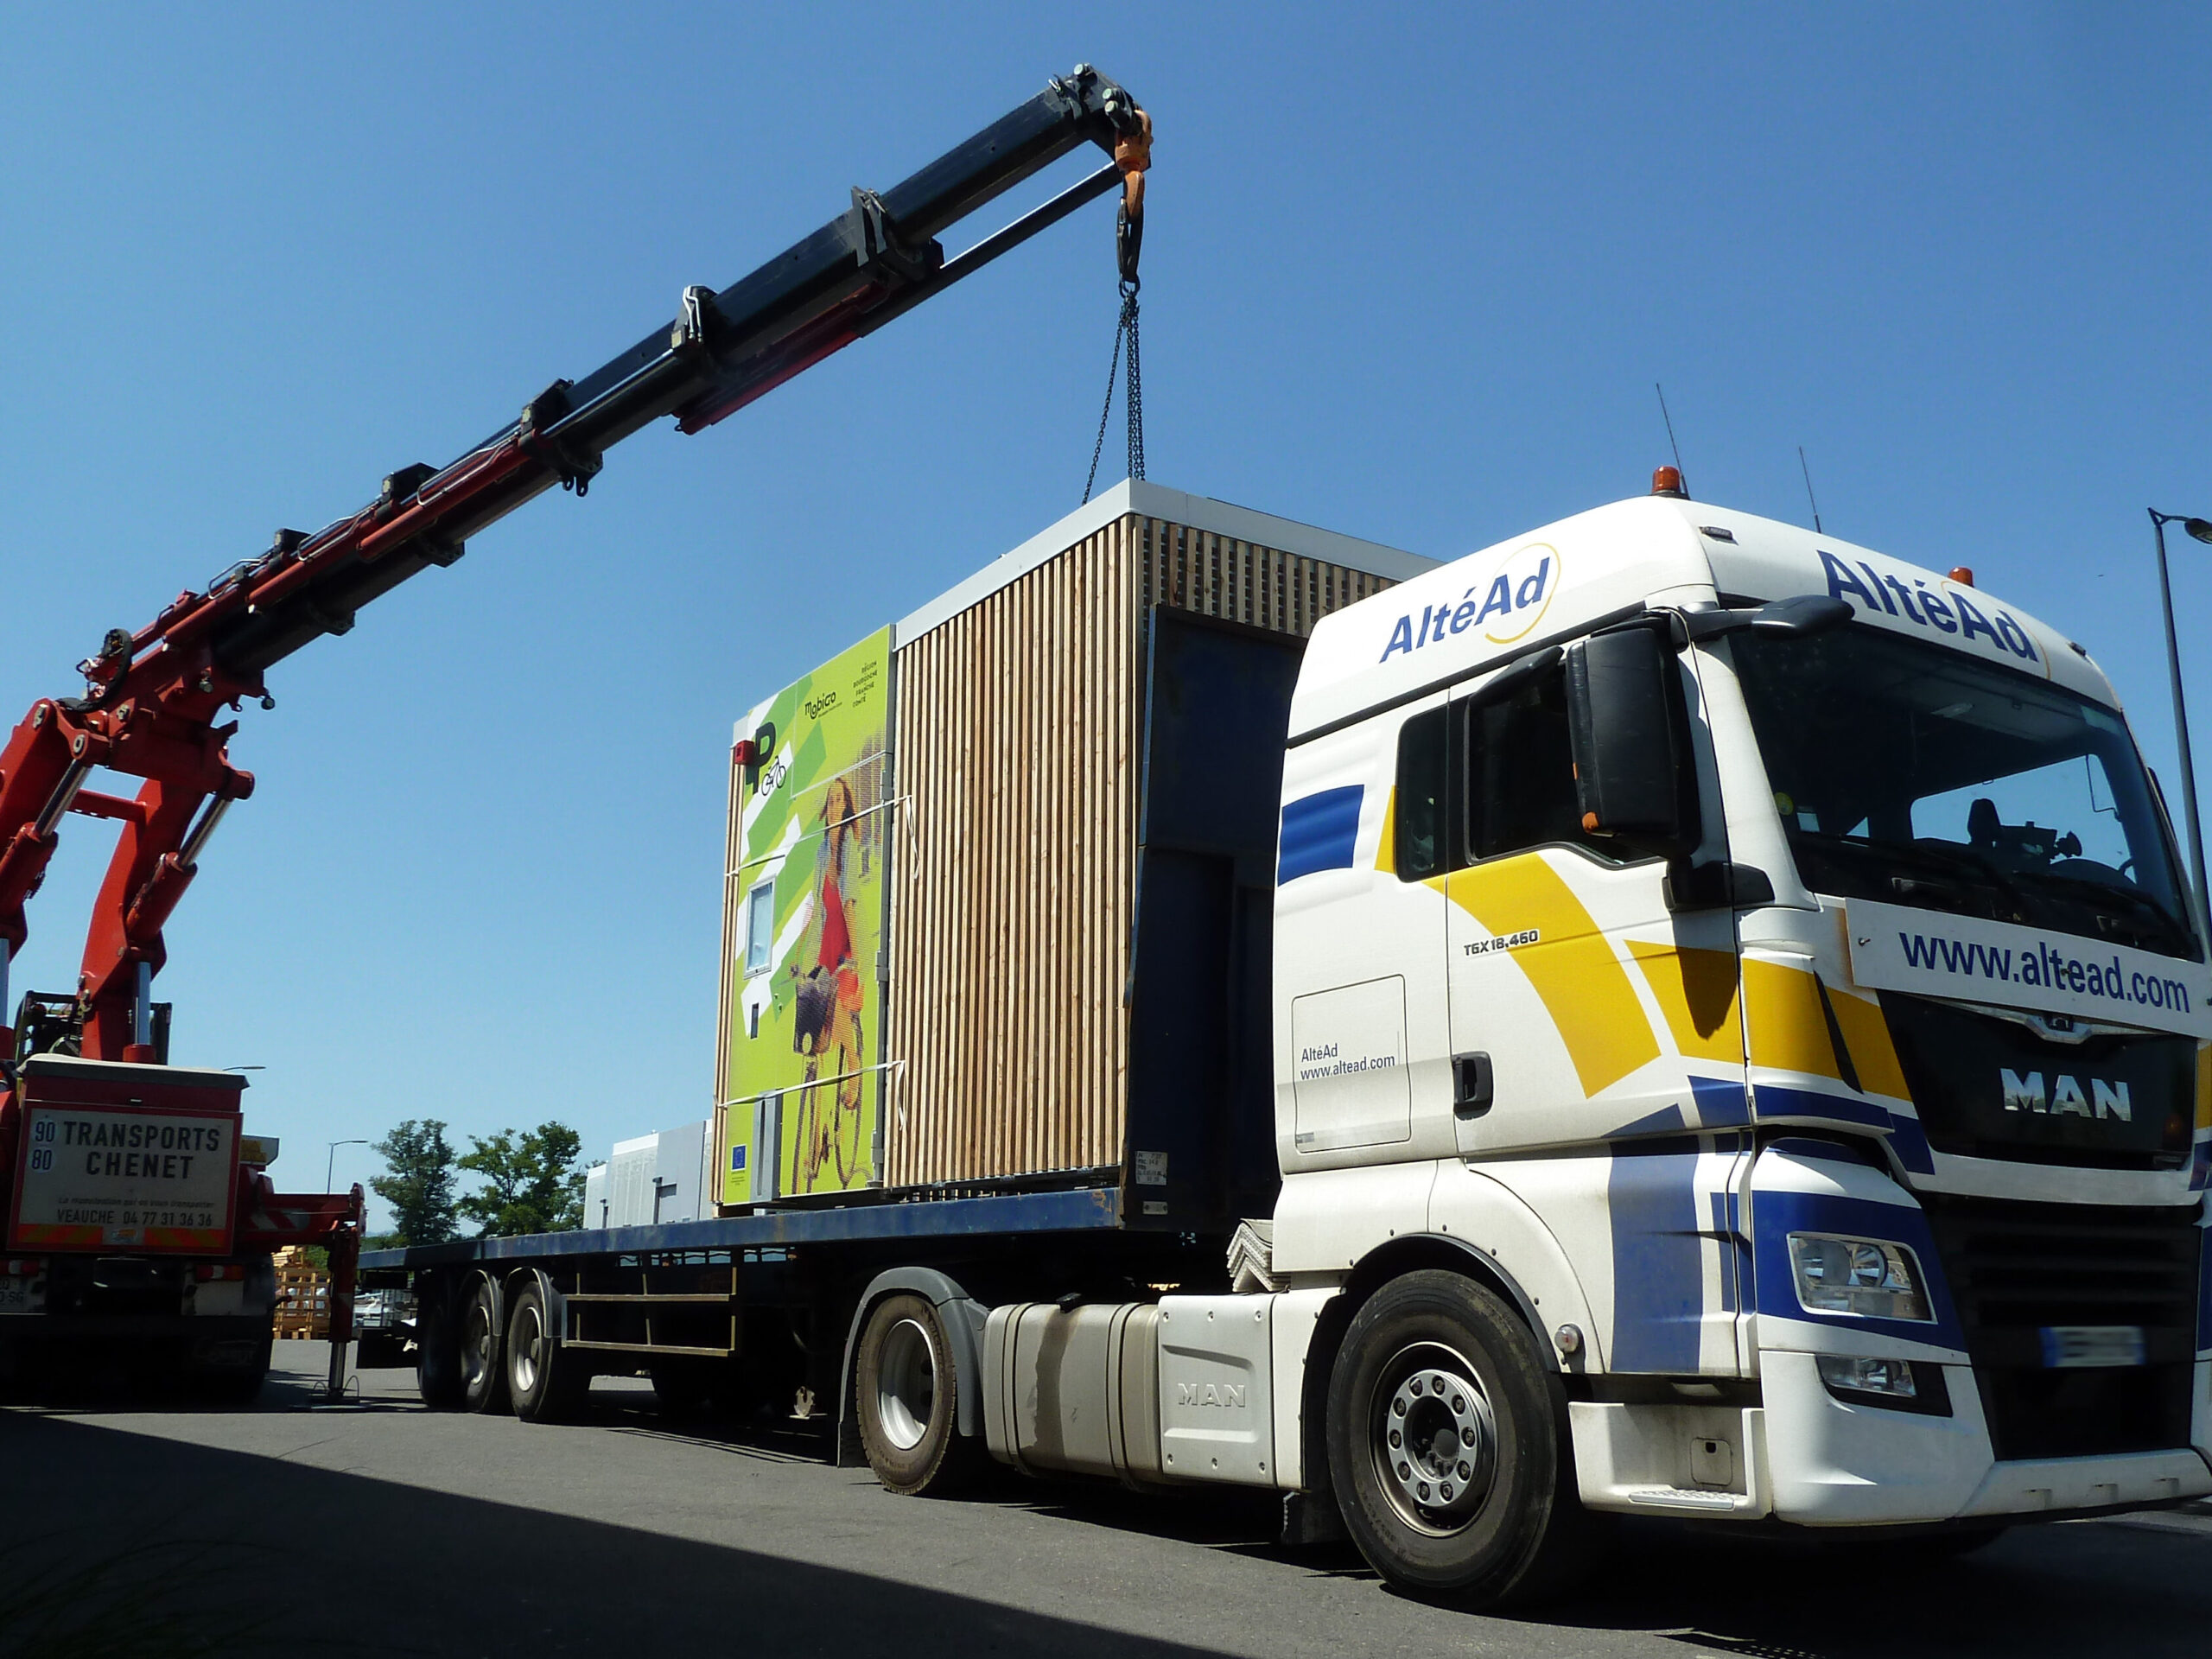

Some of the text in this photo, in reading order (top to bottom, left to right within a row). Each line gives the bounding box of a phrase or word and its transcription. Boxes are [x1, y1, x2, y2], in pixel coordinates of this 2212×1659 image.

[1379, 556, 1550, 664] AltéAd
[1816, 550, 2039, 662] AltéAd
[1898, 931, 2191, 1014] www.altead.com
[1300, 1055, 1395, 1080] www.altead.com
[1301, 1043, 1338, 1063] AltéAd
[1999, 1068, 2132, 1122] MAN
[35, 1122, 220, 1152] 90 TRANSPORTS
[32, 1149, 194, 1179] 80 CHENET
[57, 1210, 213, 1227] VEAUCHE 04 77 31 36 36
[1178, 1383, 1245, 1408] MAN
